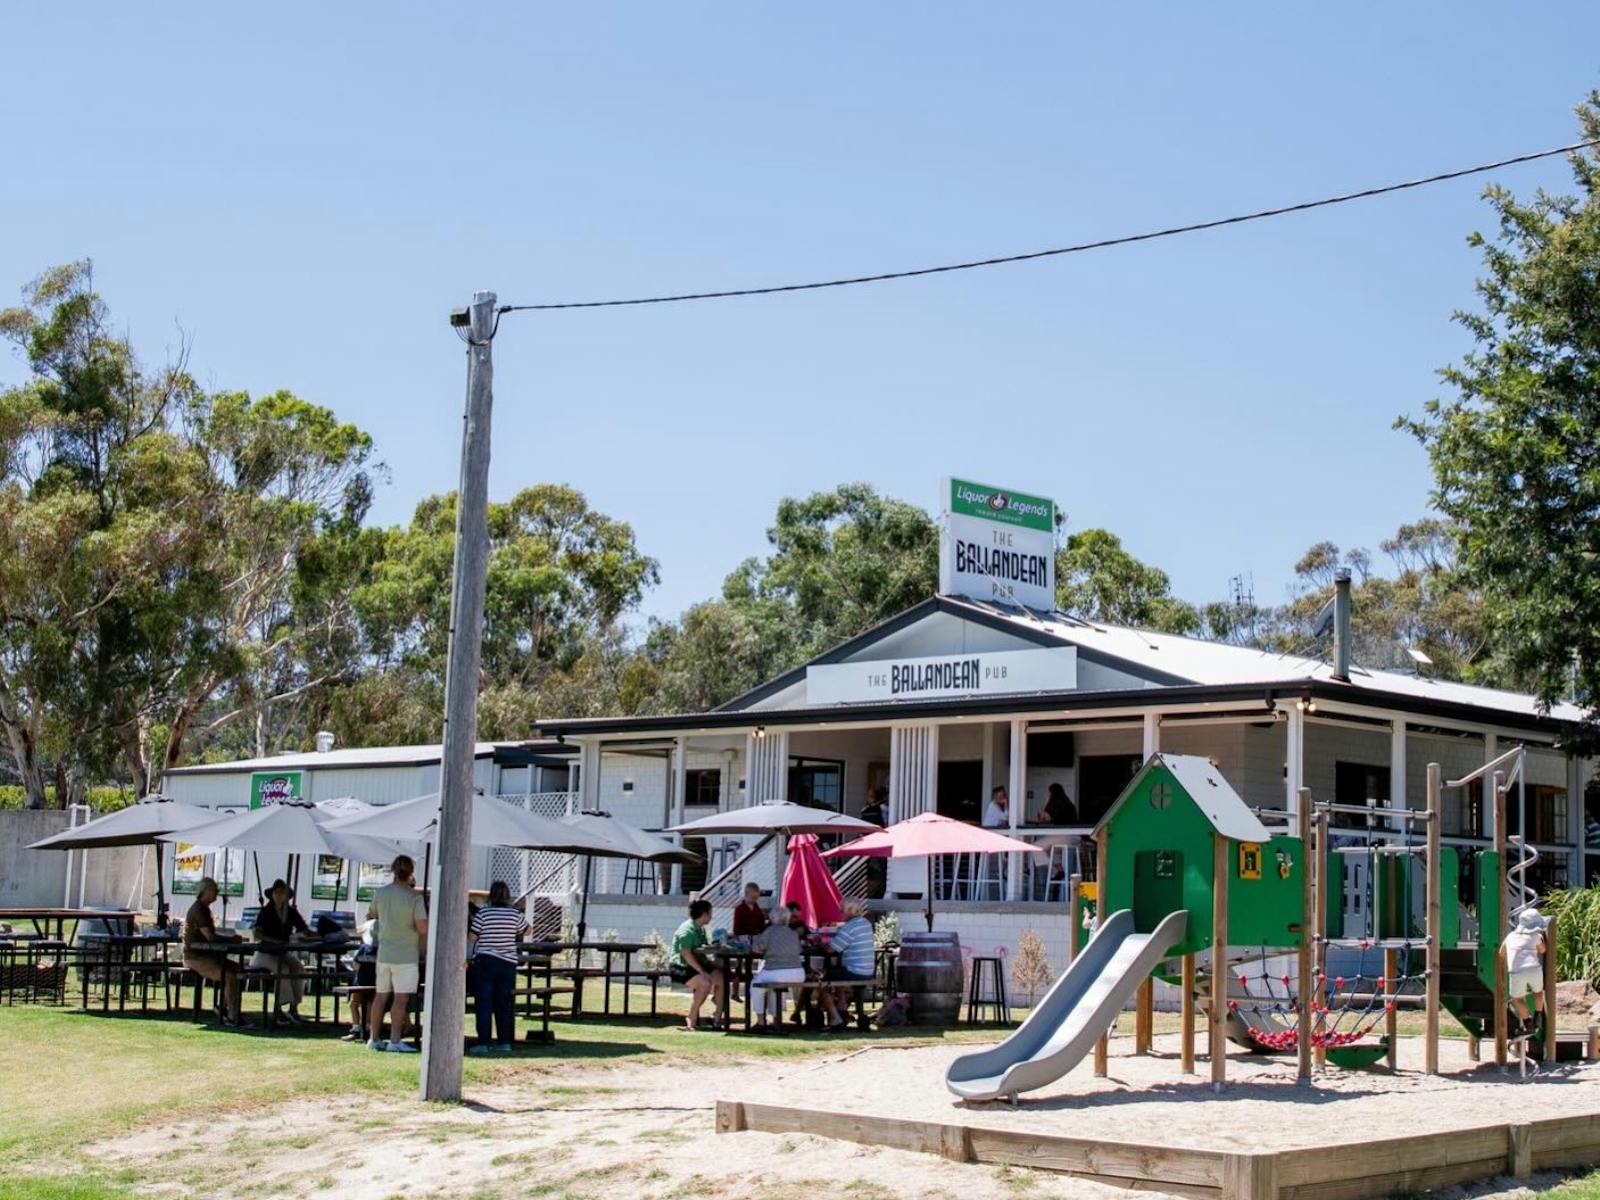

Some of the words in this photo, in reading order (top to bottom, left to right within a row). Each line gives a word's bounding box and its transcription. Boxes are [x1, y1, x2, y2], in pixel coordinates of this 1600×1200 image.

[956, 486, 989, 504] Liquor
[1007, 497, 1048, 517] Legends
[992, 530, 1013, 546] THE
[956, 539, 1047, 588] BALLANDEAN
[992, 583, 1014, 599] PUB
[868, 674, 887, 687] THE
[891, 659, 980, 694] BALLANDEAN
[985, 666, 1008, 679] PUB
